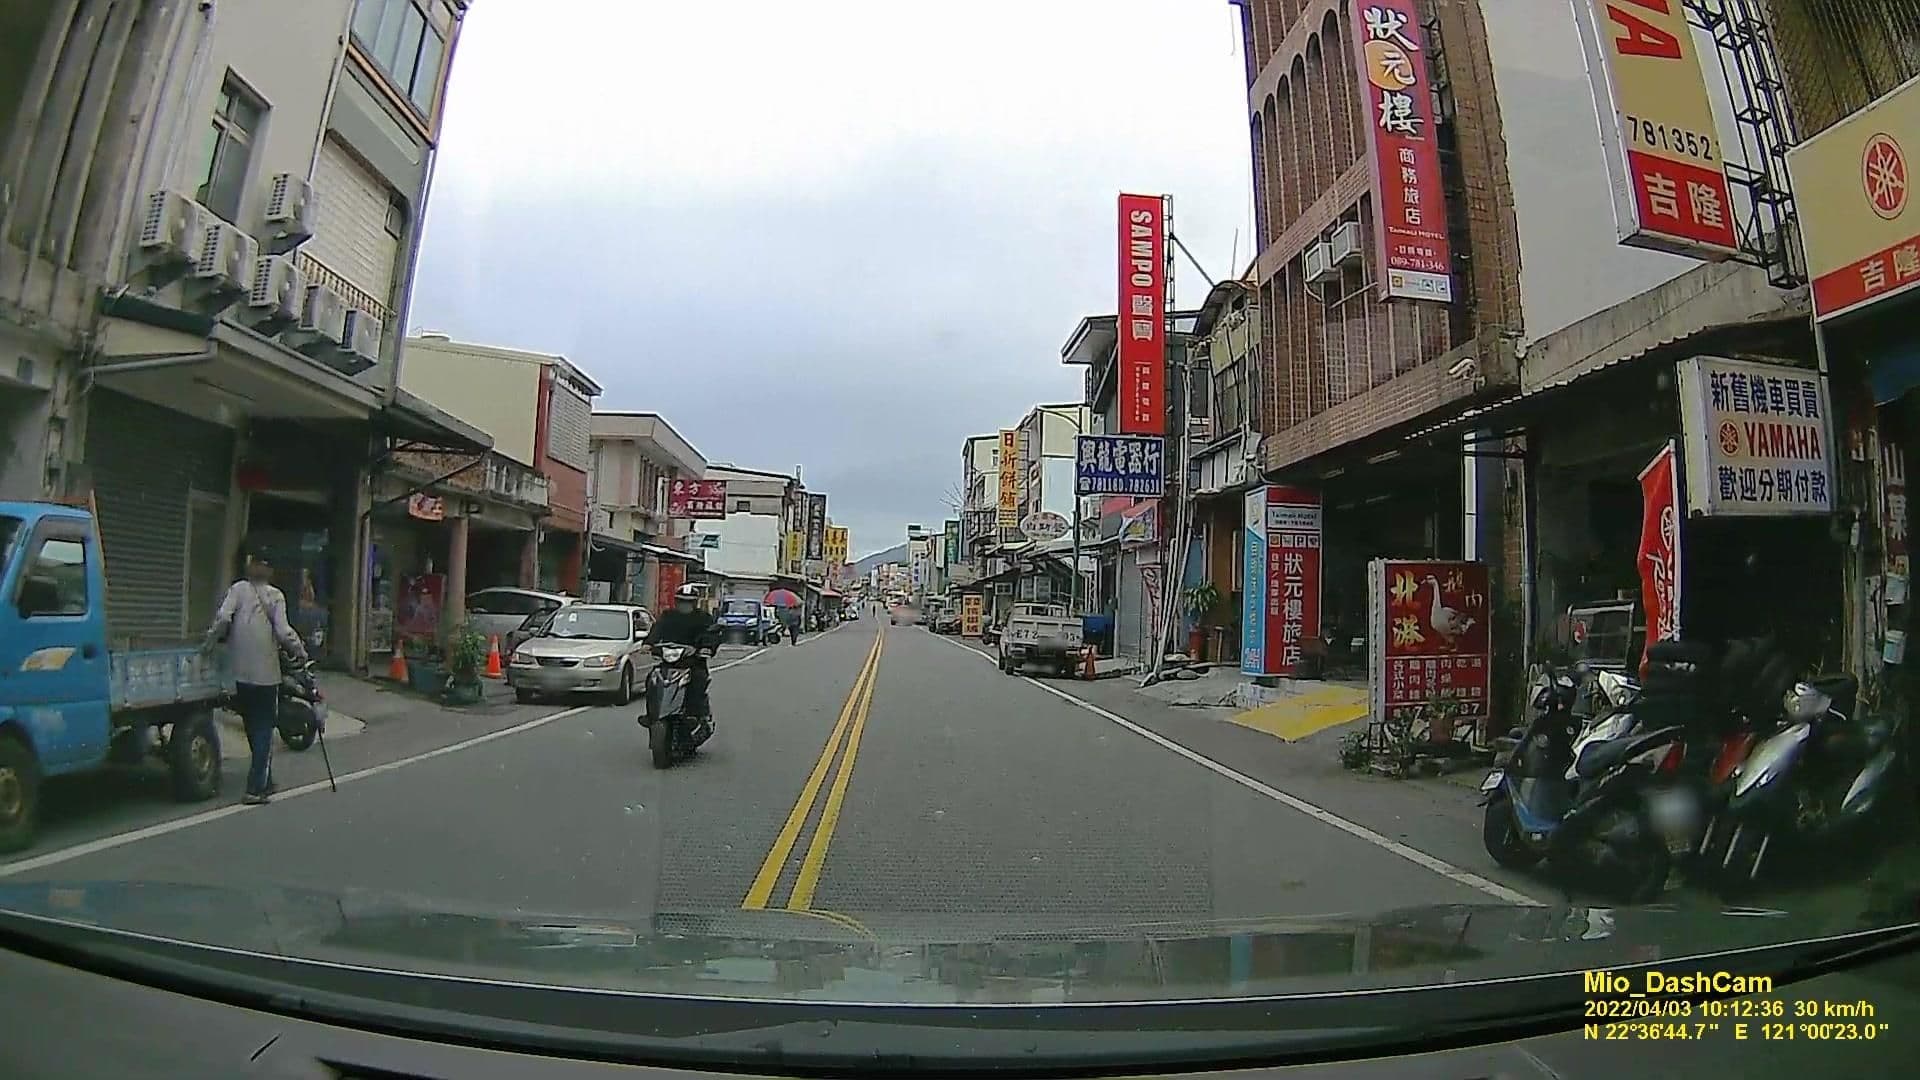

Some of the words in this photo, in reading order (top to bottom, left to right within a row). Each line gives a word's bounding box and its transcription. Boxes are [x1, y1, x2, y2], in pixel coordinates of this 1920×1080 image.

[1607, 0, 1682, 60] A
[1363, 7, 1424, 135] 狀元樓
[1626, 115, 1714, 161] 781352
[1398, 147, 1422, 226] 商務旅店
[1642, 172, 1726, 230] 吉隆
[1130, 209, 1153, 287] SAMPO
[1859, 243, 1920, 294] 吉隆
[1710, 370, 1820, 419] 新舊機車買賣
[1080, 439, 1161, 475] 興龍電器行
[1743, 421, 1822, 459] YAMAHA
[1717, 465, 1828, 503] 歡迎分期付款
[1281, 552, 1303, 667] 狀元樓旅店
